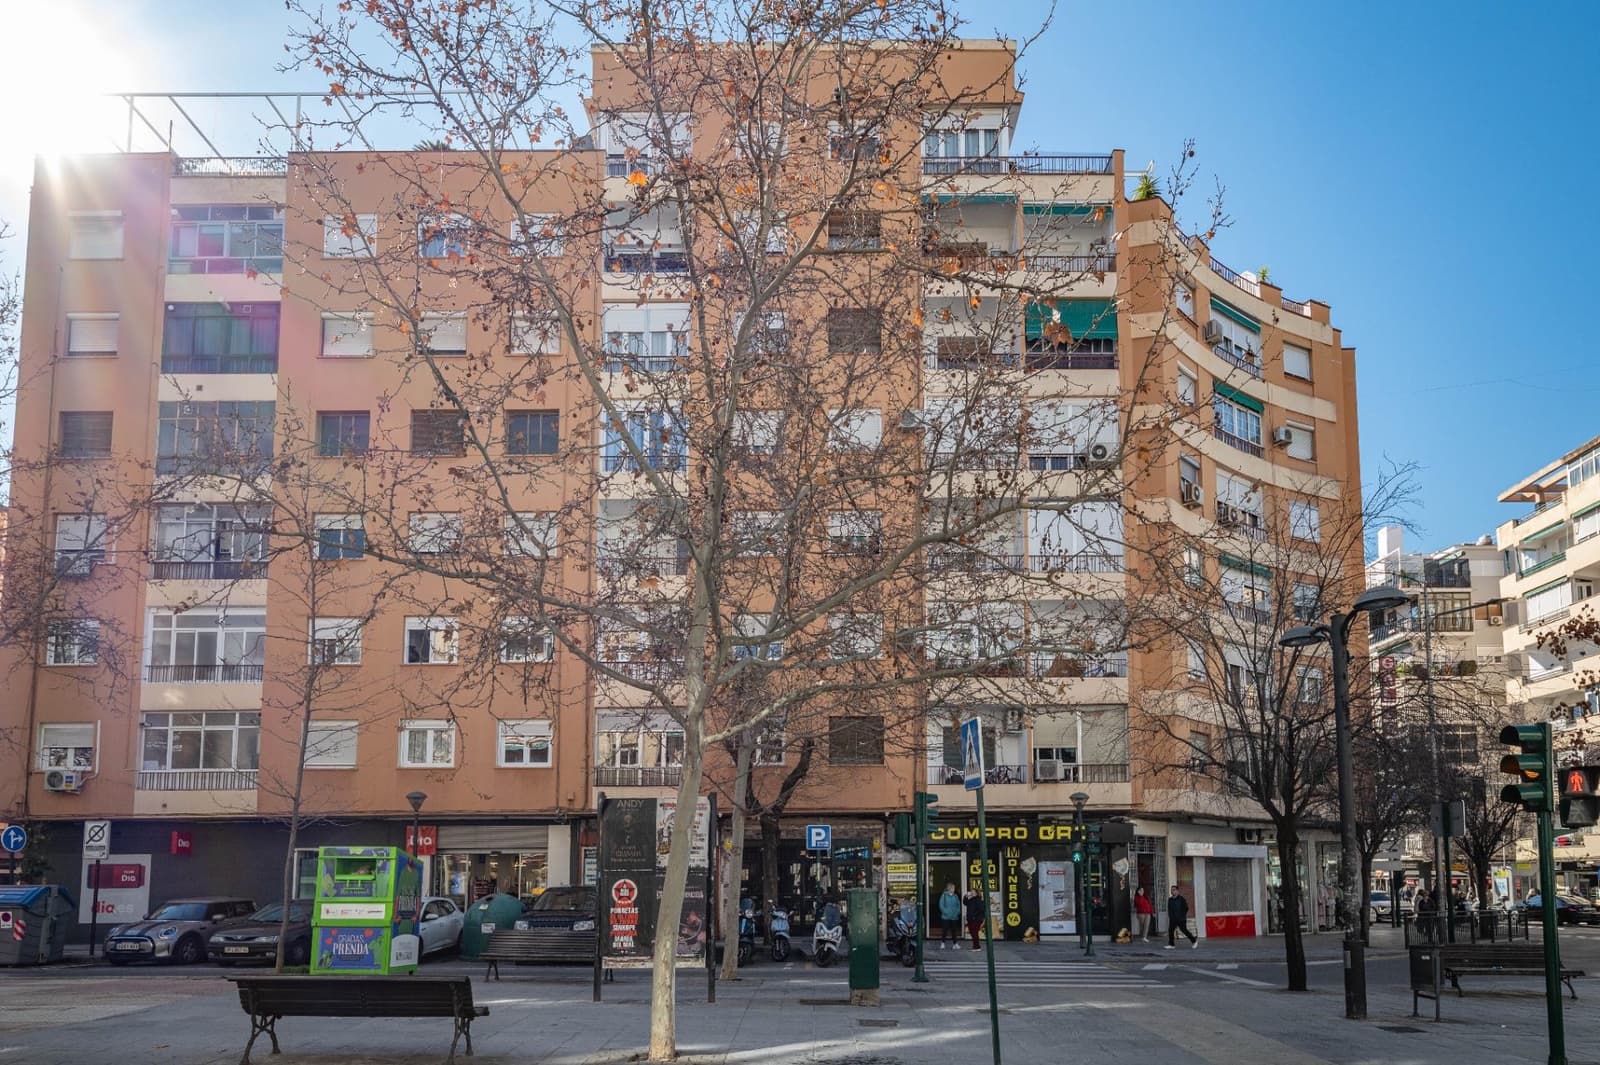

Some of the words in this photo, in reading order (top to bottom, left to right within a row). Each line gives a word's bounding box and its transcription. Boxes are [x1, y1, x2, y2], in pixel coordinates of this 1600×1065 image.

[617, 799, 644, 808] ANDY
[811, 828, 826, 847] P
[931, 827, 1028, 840] COMPRO
[1008, 859, 1018, 910] DINERO
[1008, 915, 1019, 923] YA
[332, 943, 369, 955] PRENDA
